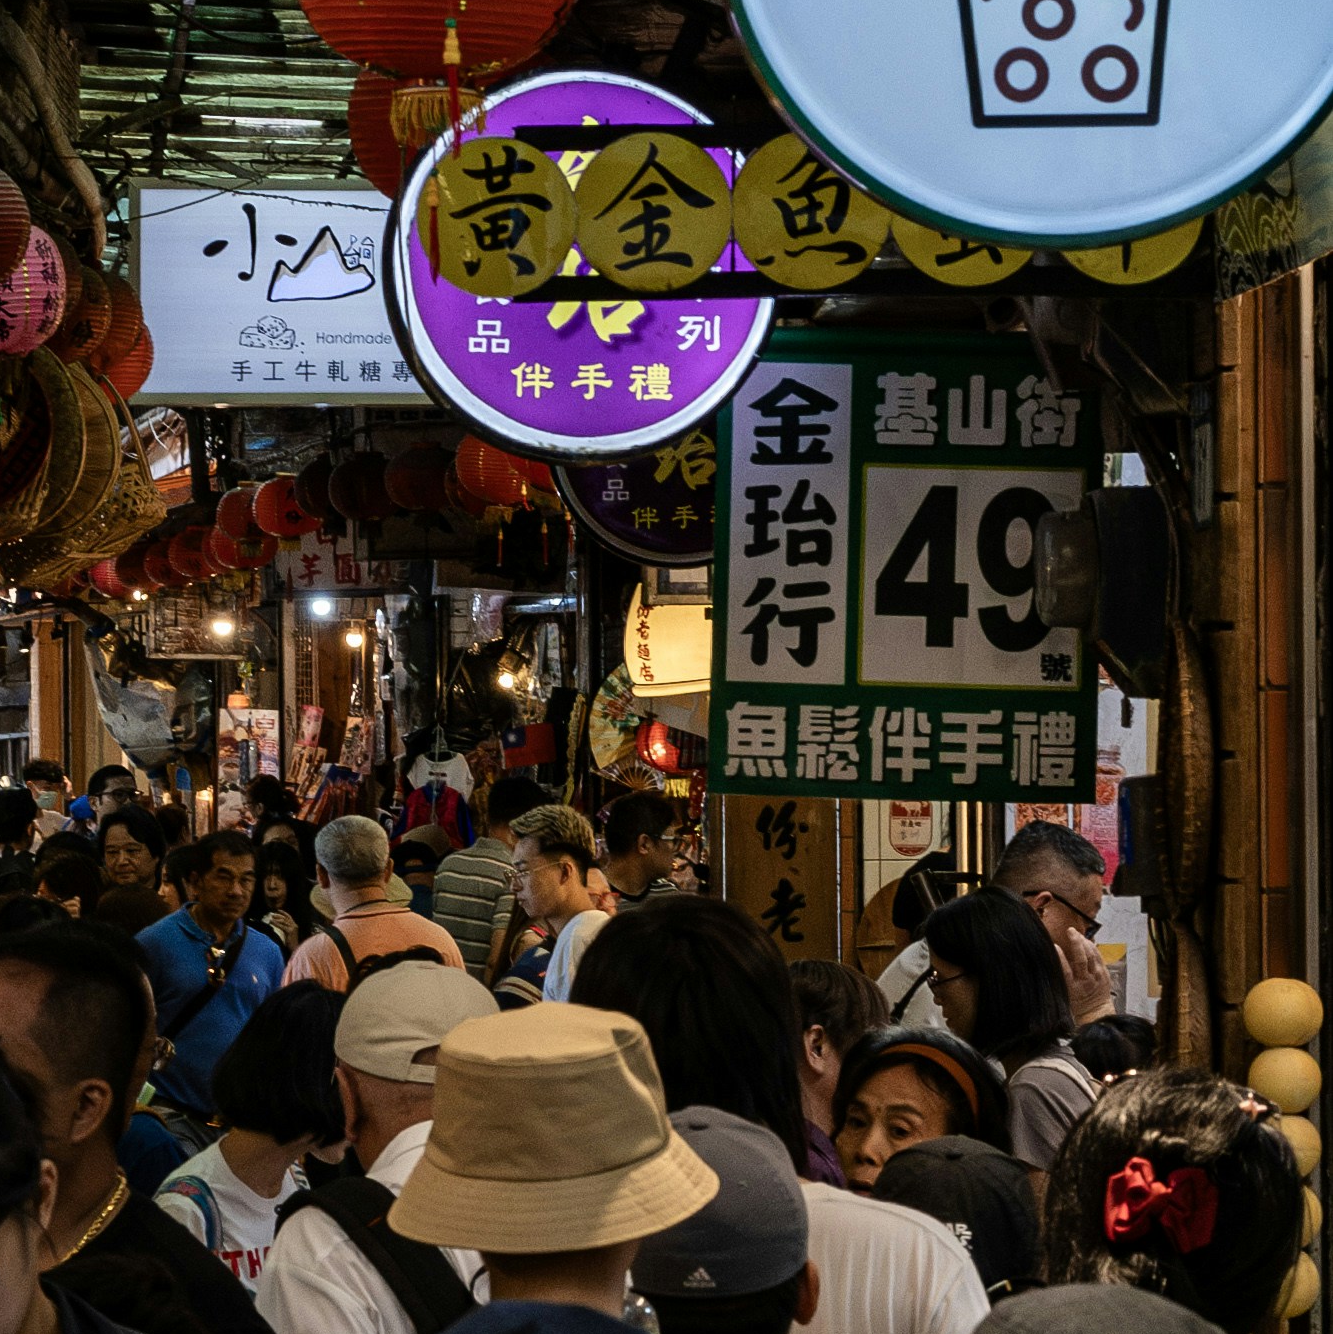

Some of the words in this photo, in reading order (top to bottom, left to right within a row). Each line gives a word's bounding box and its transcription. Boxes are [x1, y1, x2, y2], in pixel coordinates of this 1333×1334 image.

[447, 141, 1134, 279] 黃金魚
[316, 332, 393, 345] Handmade
[511, 361, 673, 401] 伴手禮
[873, 370, 1082, 448] 基山街
[630, 504, 716, 531] 伴手
[724, 700, 1077, 789] 魚鬆伴手禮
